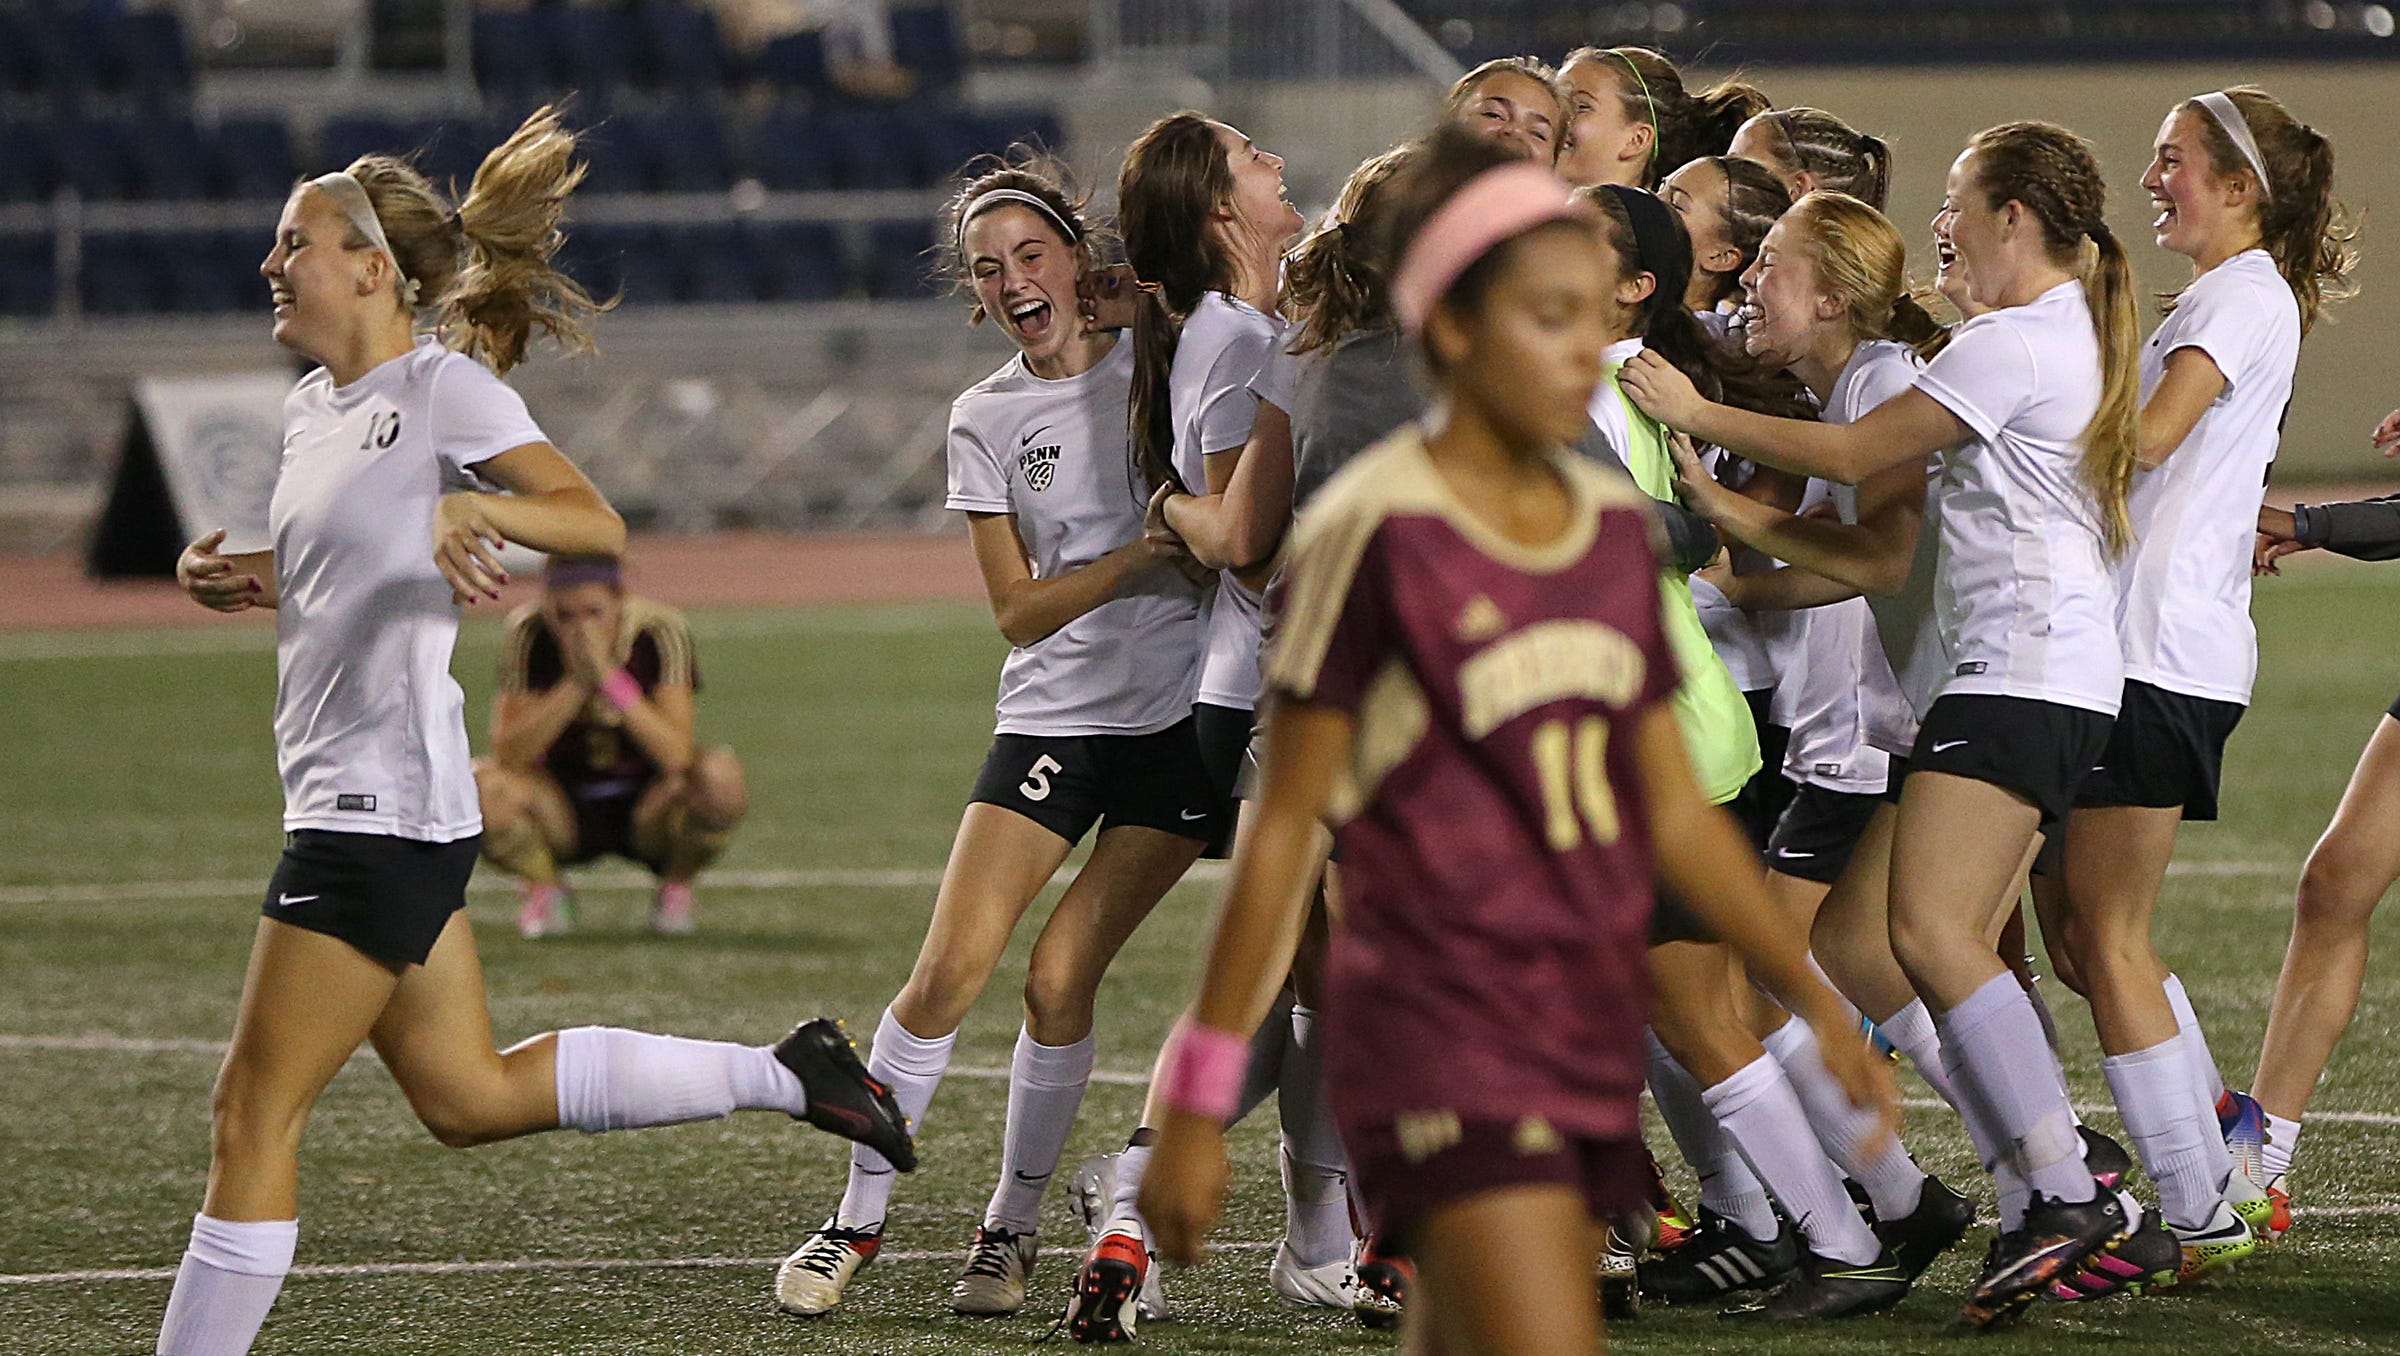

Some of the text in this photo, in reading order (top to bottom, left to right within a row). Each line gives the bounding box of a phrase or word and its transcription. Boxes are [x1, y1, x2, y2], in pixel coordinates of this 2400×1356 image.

[360, 411, 400, 450] 10
[1019, 445, 1061, 471] PENN
[1019, 753, 1063, 801] 5
